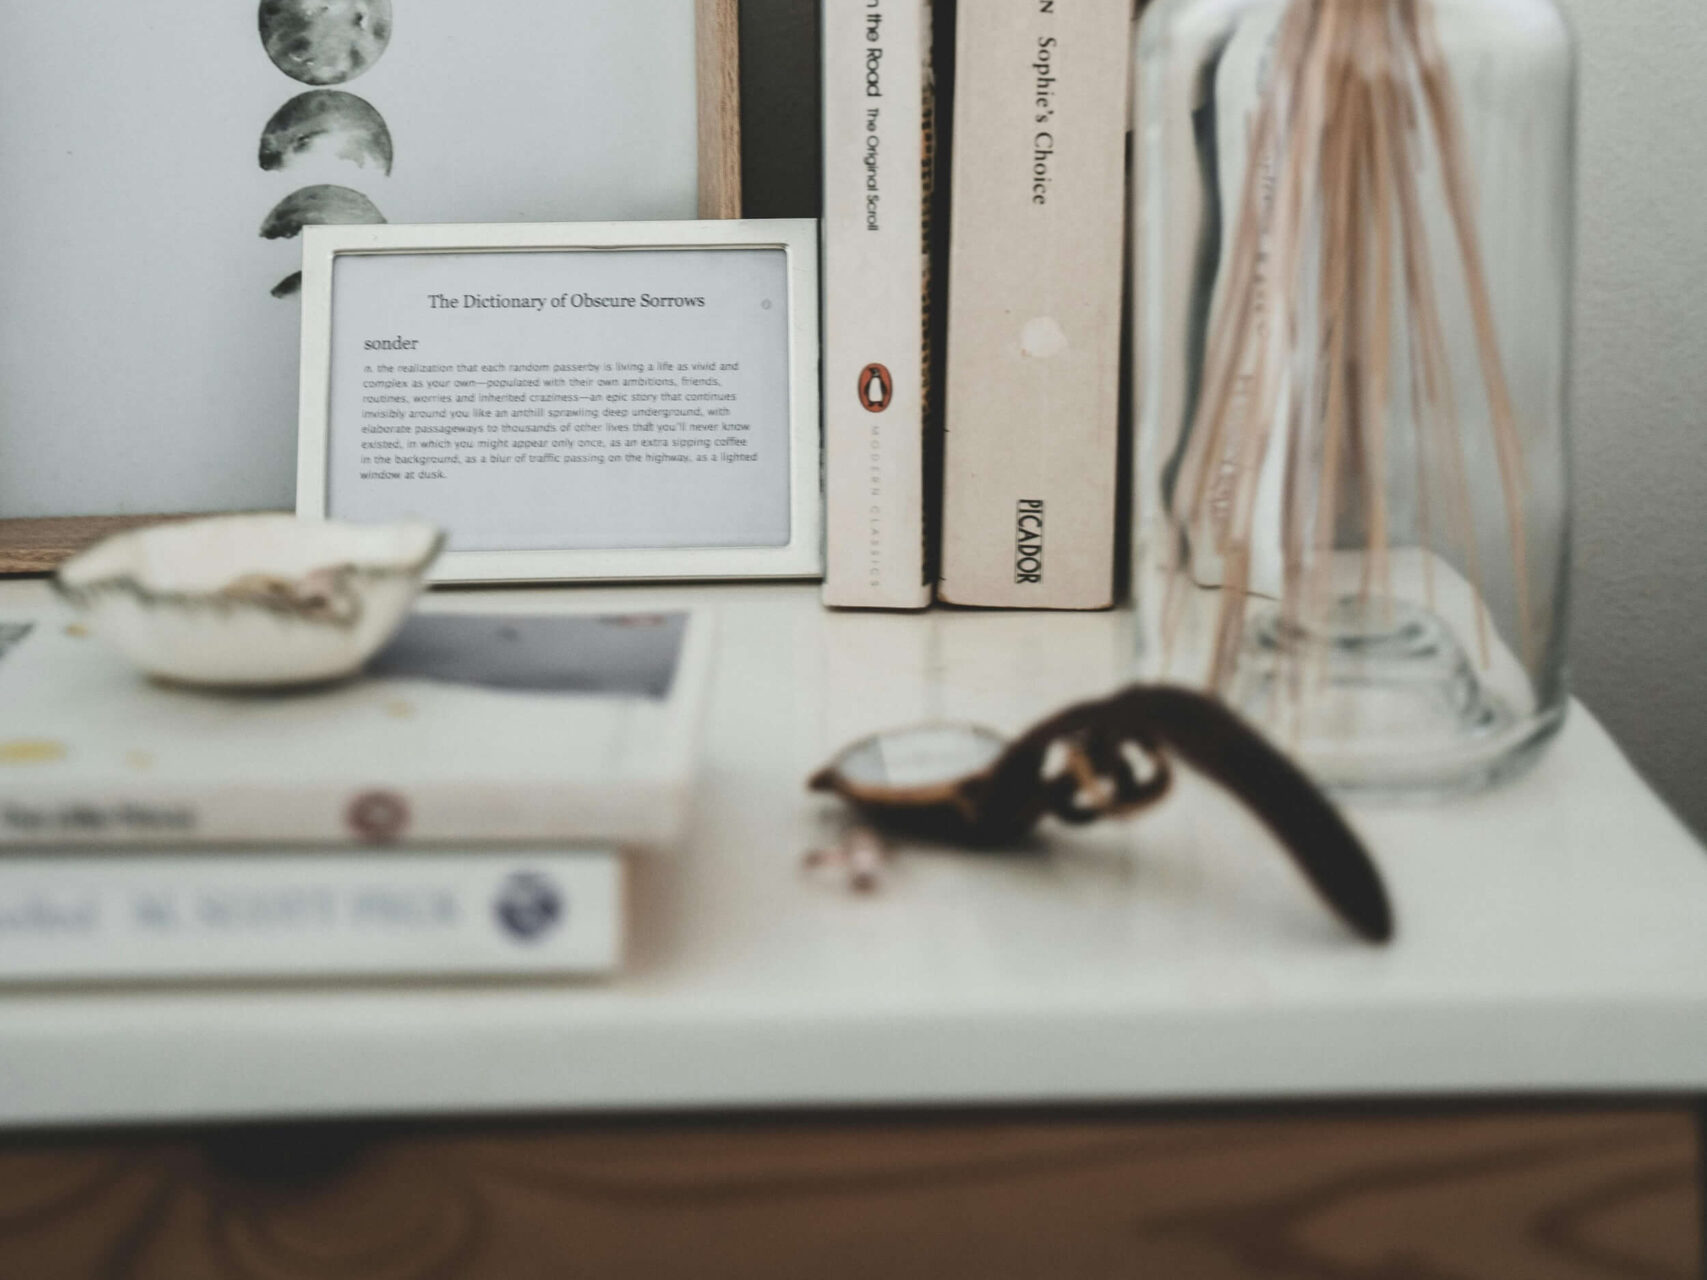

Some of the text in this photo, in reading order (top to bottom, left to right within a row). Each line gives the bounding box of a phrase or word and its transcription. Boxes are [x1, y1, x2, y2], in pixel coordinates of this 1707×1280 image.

[865, 13, 883, 42] the
[865, 48, 884, 97] Road
[1031, 36, 1057, 124] Sophie's
[866, 108, 880, 132] The
[863, 135, 880, 192] Original
[1032, 131, 1054, 205] Choice
[866, 194, 880, 231] Scroll
[428, 293, 705, 312] The Dictionary of Obscure Sorrows
[364, 336, 418, 350] sonder
[377, 362, 394, 373] the
[397, 362, 454, 373] realization
[456, 362, 478, 372] that
[480, 362, 506, 372] each
[509, 362, 550, 372] random
[553, 361, 601, 374] passerby
[603, 361, 613, 372] is
[615, 361, 645, 374] living
[647, 362, 655, 371] a
[657, 361, 674, 371] life
[676, 362, 689, 371] as
[691, 361, 717, 371] vivid
[719, 361, 740, 371] and
[362, 377, 408, 390] complex
[411, 379, 424, 388] as
[427, 379, 450, 390] your
[543, 376, 565, 387] with
[569, 376, 593, 387] their
[597, 378, 619, 387] own
[413, 393, 452, 404] worries
[455, 393, 476, 403] and
[479, 393, 526, 403] inherited
[606, 392, 628, 405] epic
[631, 393, 657, 405] story
[660, 391, 682, 402] that
[685, 391, 737, 402] continues
[362, 408, 406, 421] invisibly
[409, 408, 446, 419] around
[450, 409, 469, 421] you
[473, 408, 492, 418] like
[495, 409, 508, 418] an
[511, 408, 544, 418] anthill
[548, 407, 599, 420] sprawling
[602, 407, 629, 420] deep
[707, 407, 731, 417] with
[360, 424, 412, 434] elaborate
[415, 425, 484, 436] passageways
[487, 424, 498, 434] to
[501, 423, 557, 433] thousands
[560, 423, 571, 433] of
[574, 423, 602, 433] other
[606, 422, 629, 433] lives
[632, 422, 654, 433] that
[690, 423, 718, 432] never
[722, 422, 751, 432] know
[407, 439, 417, 449] in
[420, 439, 451, 449] which
[454, 440, 474, 451] you
[477, 438, 509, 451] might
[512, 439, 548, 451] appear
[552, 438, 574, 451] only
[610, 439, 622, 448] as
[624, 439, 638, 448] an
[641, 438, 669, 448] extra
[672, 437, 712, 450] sipping
[714, 437, 748, 447] coffee
[361, 454, 371, 465] in
[374, 454, 391, 465] the
[464, 455, 477, 464] as
[480, 455, 487, 464] a
[489, 453, 512, 464] blur
[514, 453, 527, 464] of
[528, 453, 561, 464] traffic
[563, 453, 605, 466] passing
[608, 454, 623, 463] on
[624, 452, 643, 463] the
[696, 453, 708, 462] as
[711, 453, 718, 462] a
[720, 452, 758, 465] lighted
[360, 469, 402, 480] window
[404, 470, 415, 480] at
[869, 425, 881, 587] MODERN CLASSICS
[1016, 498, 1044, 585] PICADOR
